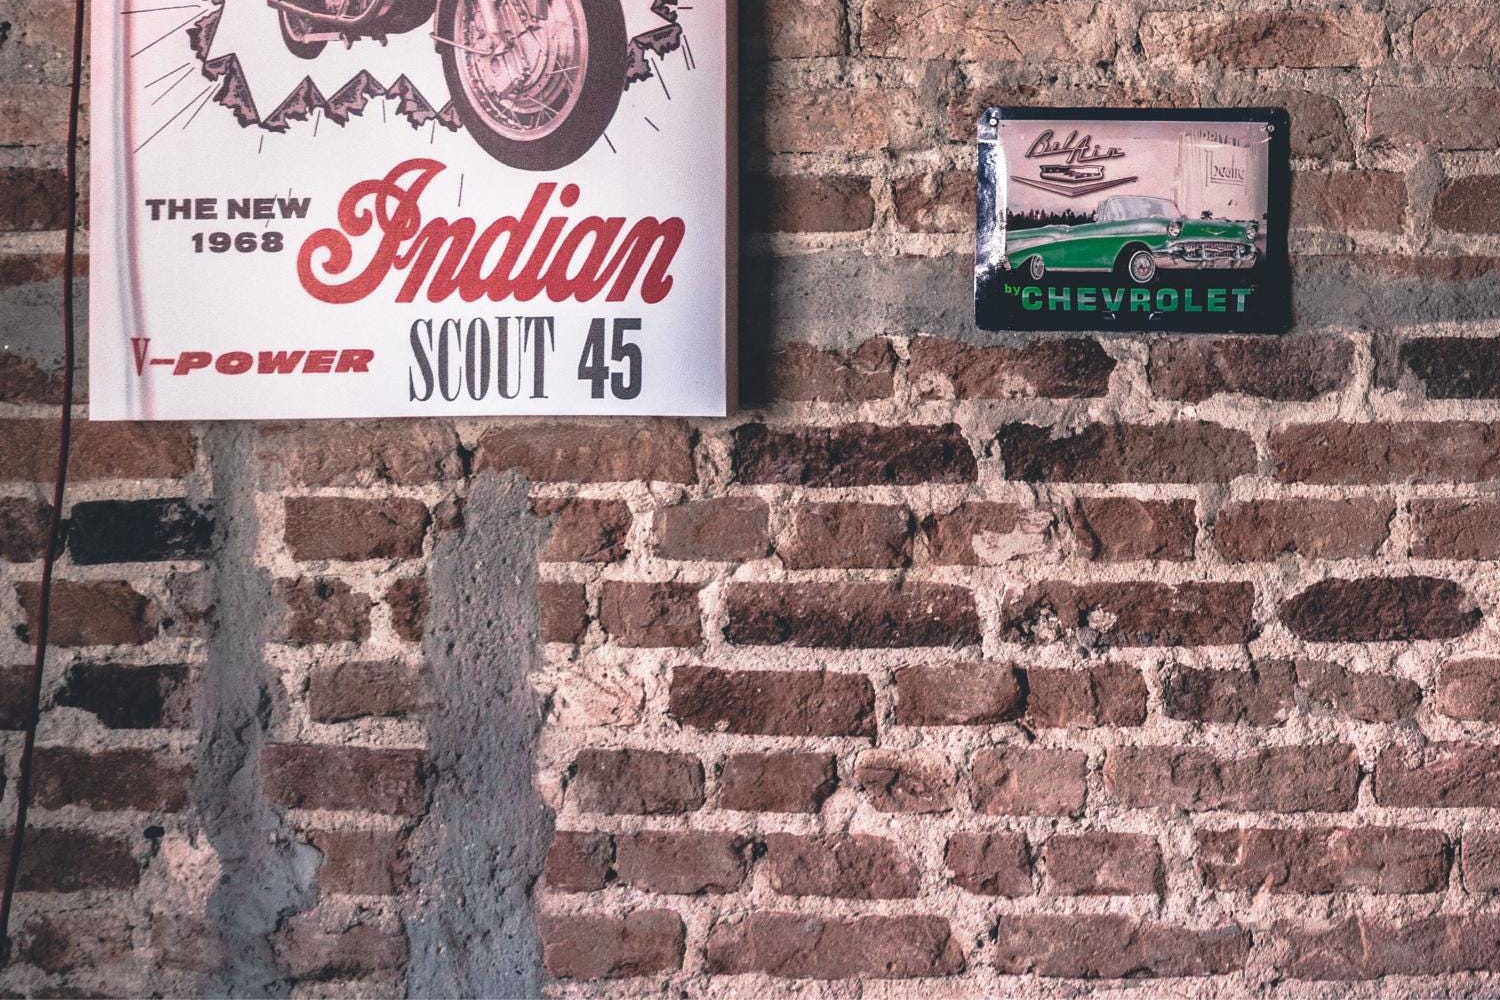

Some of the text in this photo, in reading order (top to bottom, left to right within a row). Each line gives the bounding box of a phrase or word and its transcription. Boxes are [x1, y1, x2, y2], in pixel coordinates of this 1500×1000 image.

[144, 197, 312, 221] THE NEW
[191, 231, 285, 254] 1968
[297, 157, 686, 304] Indian
[1004, 284, 1252, 313] by CHEVROLET
[131, 337, 375, 376] V-POWER
[408, 316, 643, 403] SCOUT 45
